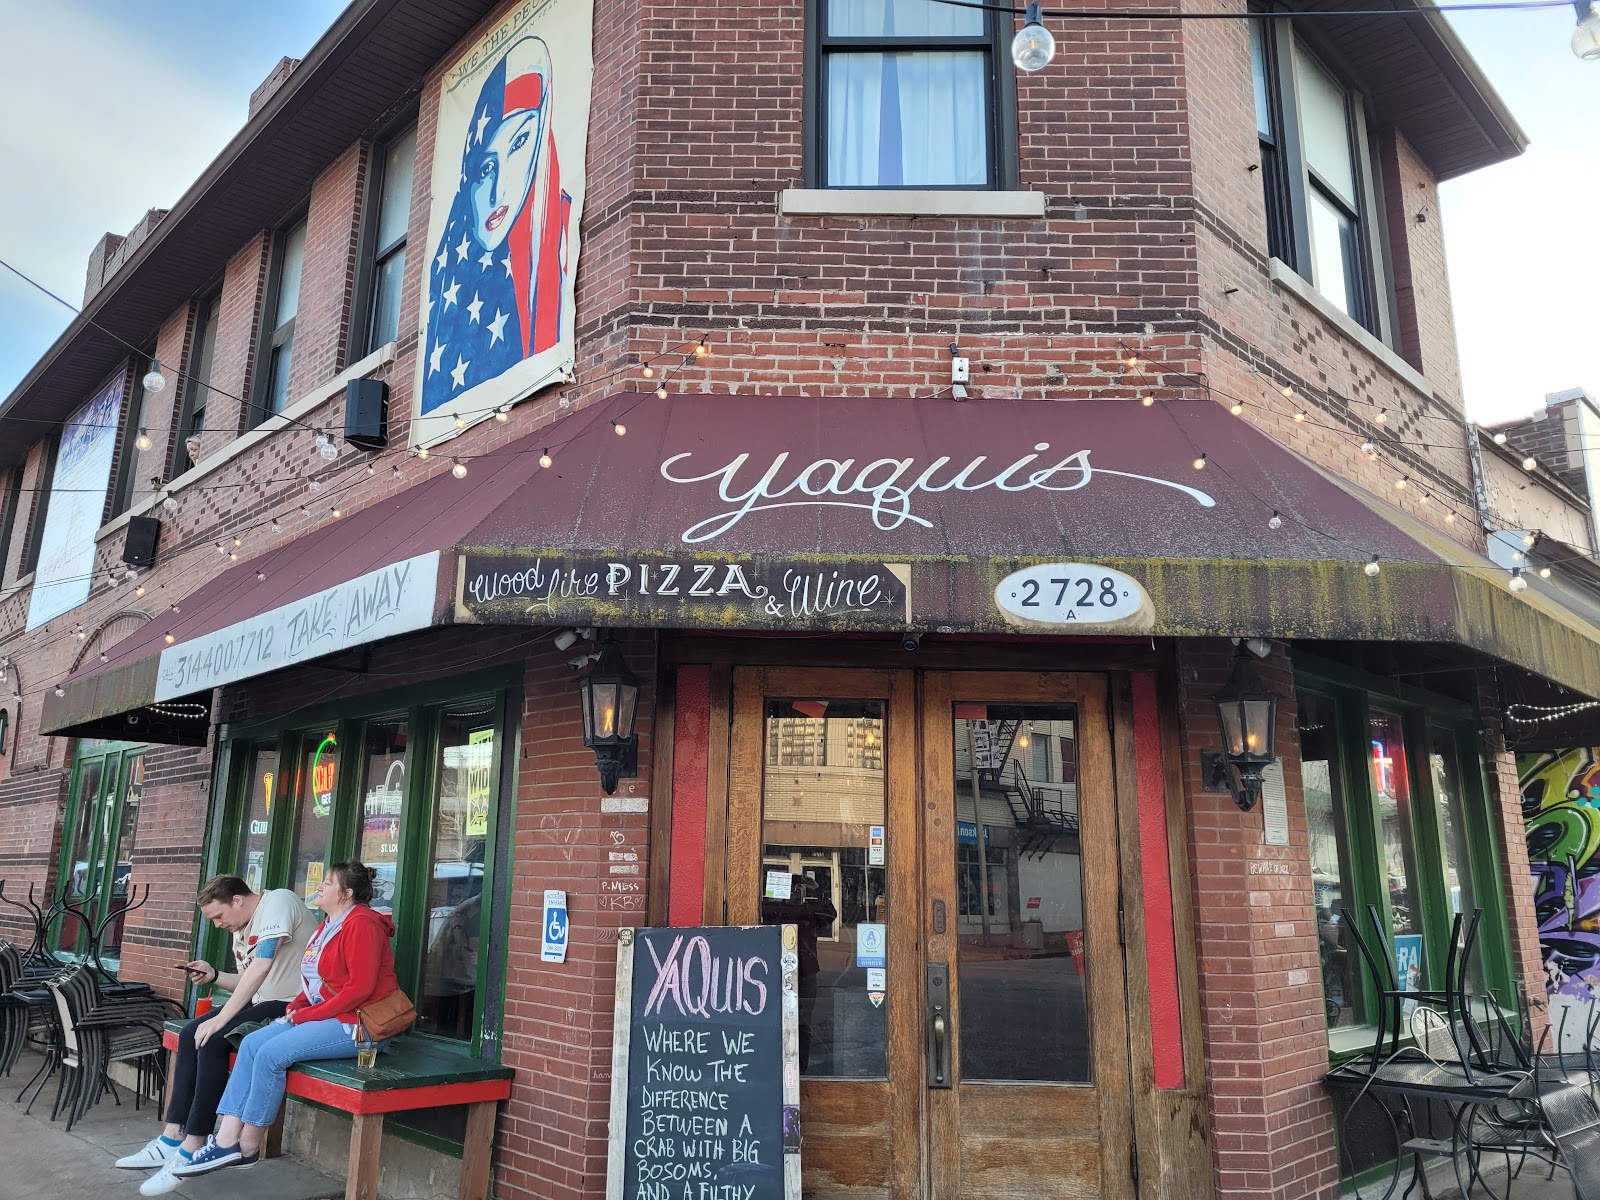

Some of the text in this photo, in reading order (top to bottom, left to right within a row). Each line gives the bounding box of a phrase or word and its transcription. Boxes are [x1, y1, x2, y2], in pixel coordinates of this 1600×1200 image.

[458, 52, 479, 77] WE
[482, 23, 509, 57] THE
[526, 568, 599, 619] fire
[605, 563, 768, 599] PIZZA
[764, 595, 785, 618] &
[783, 568, 882, 618] Wine
[1021, 577, 1118, 607] 2728
[161, 668, 174, 679] CALL
[287, 589, 338, 652] TAKE
[346, 561, 411, 639] AWAY
[1065, 609, 1077, 620] A
[866, 930, 876, 941] A
[1396, 946, 1418, 971] RA
[643, 1022, 755, 1055] WHERE WE
[647, 1055, 750, 1083] KNOW THE
[641, 1085, 729, 1111] DIFFERENCE
[641, 1110, 753, 1137] BETWEEN A
[634, 1136, 761, 1165] CRAB WITH BIG
[636, 1180, 756, 1200] AND A FILTHY
